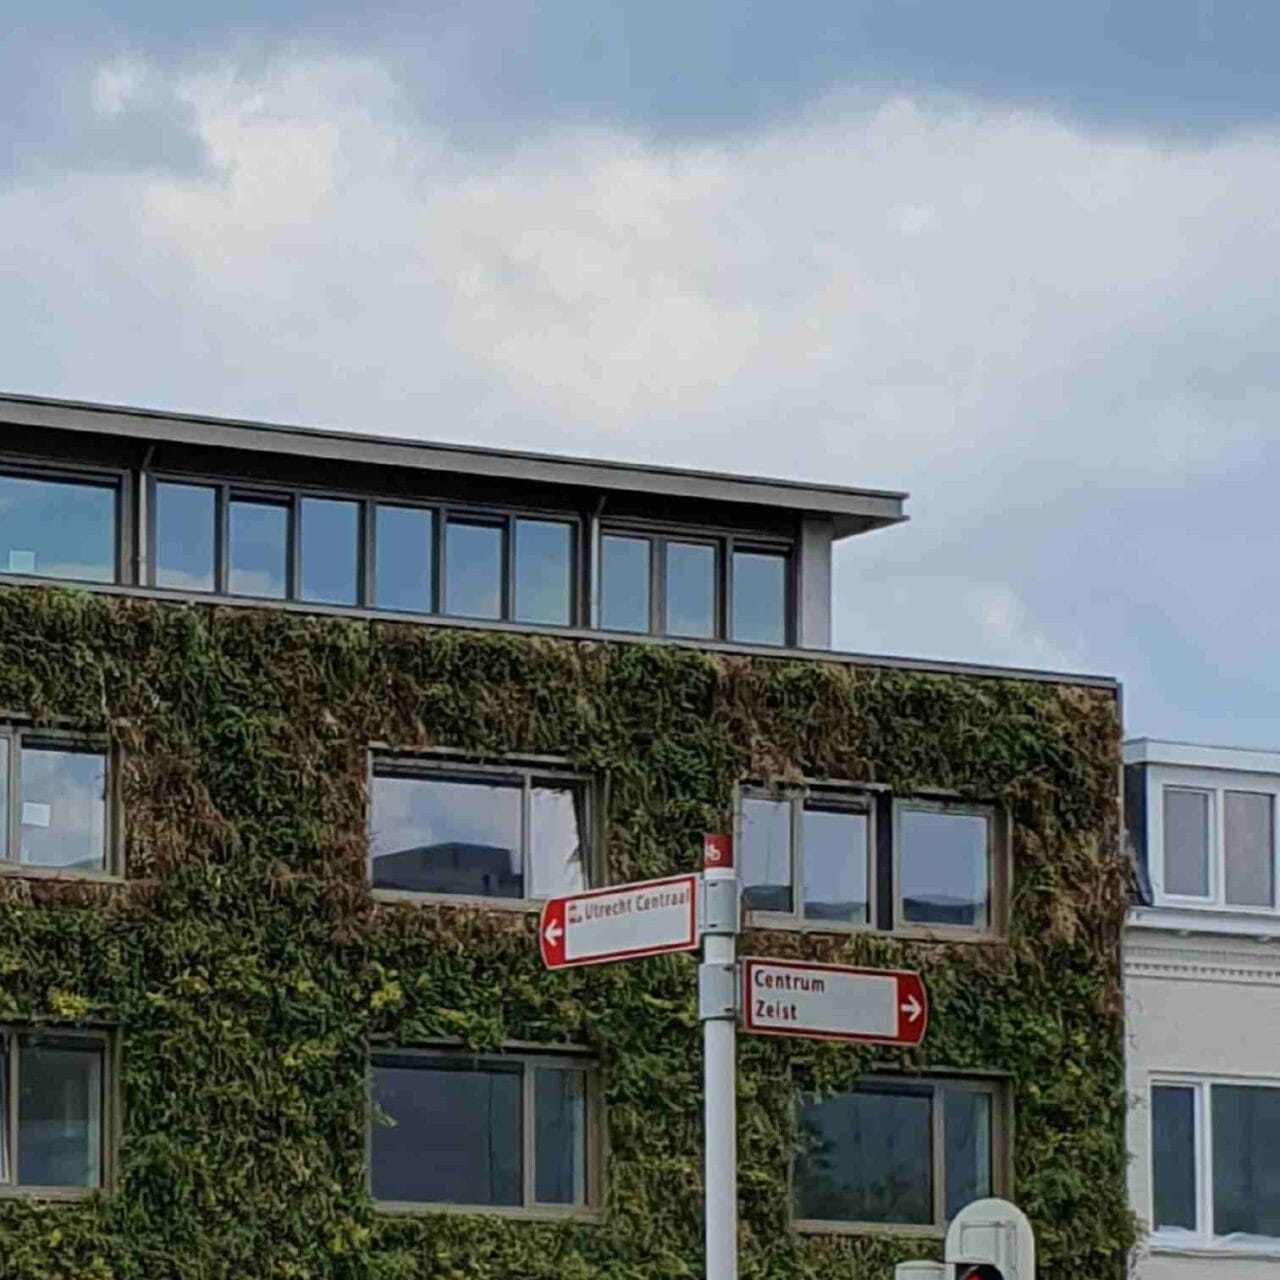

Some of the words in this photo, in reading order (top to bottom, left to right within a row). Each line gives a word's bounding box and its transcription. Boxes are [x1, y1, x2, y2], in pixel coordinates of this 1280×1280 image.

[585, 899, 632, 919] Utrecht
[636, 888, 690, 911] Centraal
[754, 969, 825, 994] Centrum
[756, 1000, 797, 1021] Zeist
